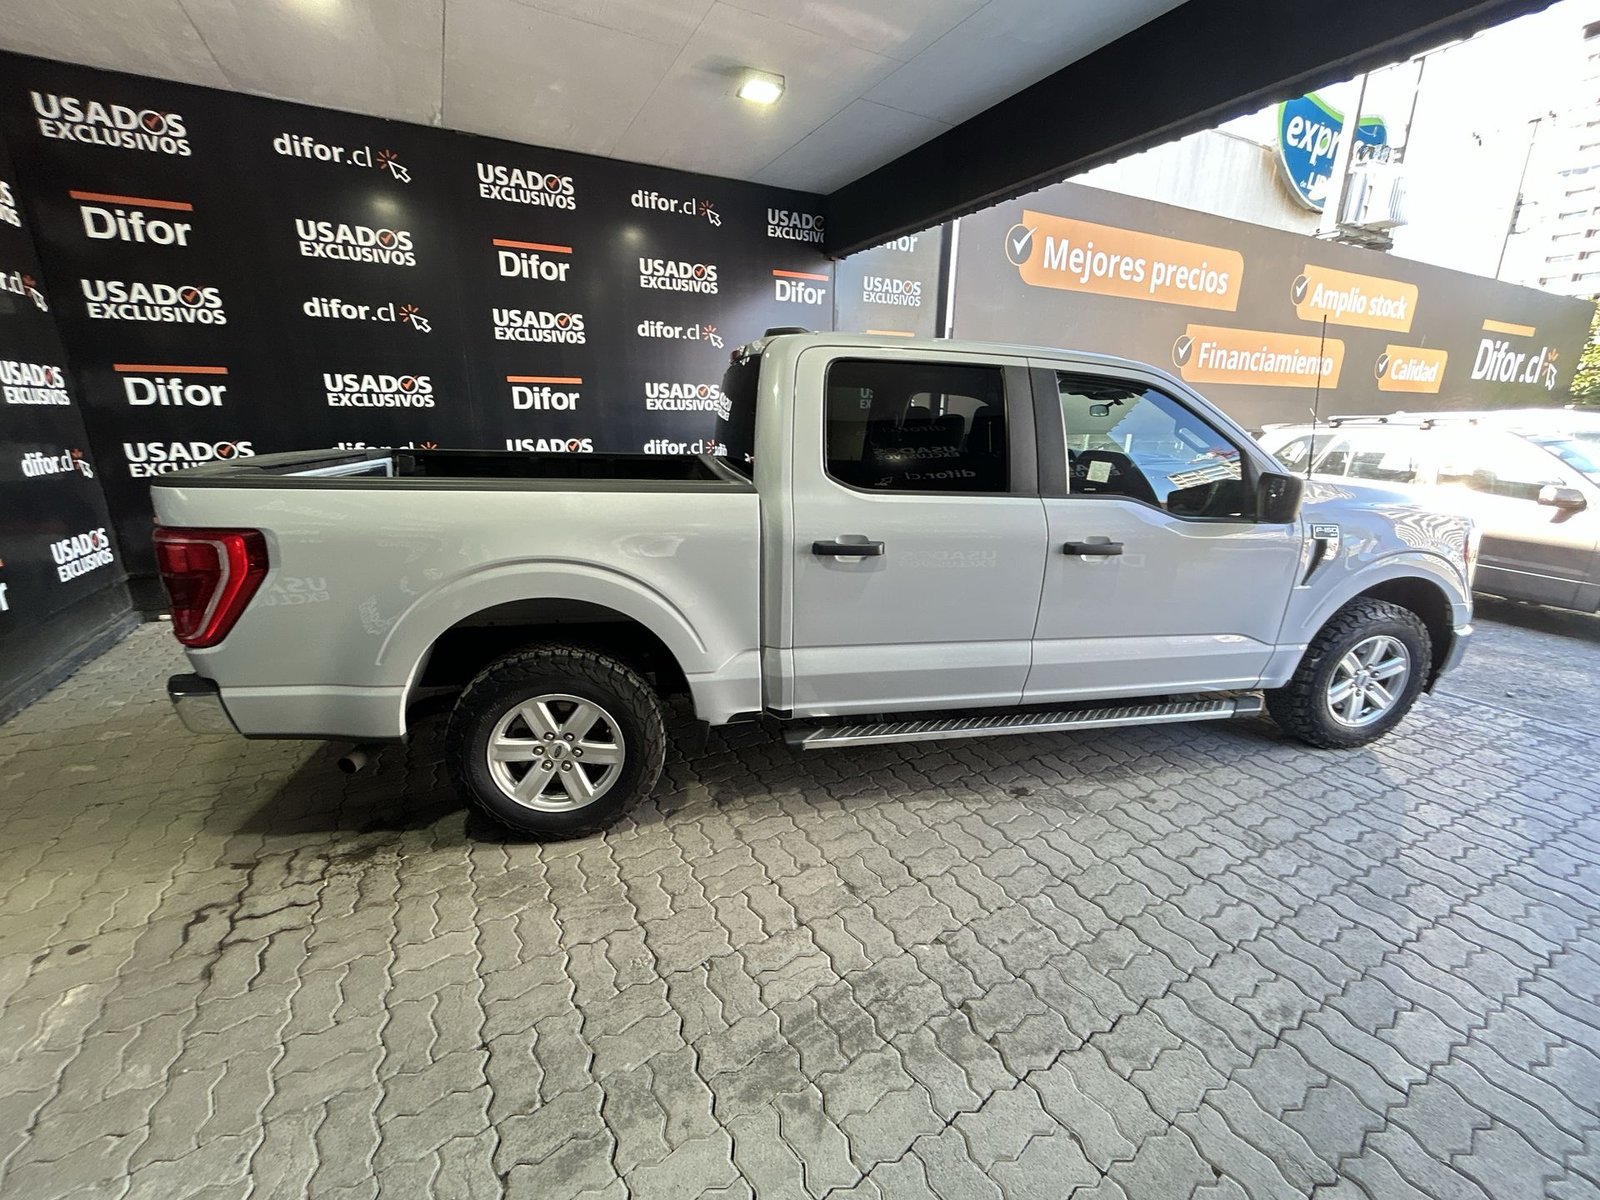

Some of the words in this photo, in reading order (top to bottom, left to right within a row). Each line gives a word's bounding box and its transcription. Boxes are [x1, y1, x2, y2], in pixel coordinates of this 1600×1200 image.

[30, 91, 187, 137] USADOS
[38, 118, 192, 156] EXCLUSIVOS
[273, 132, 373, 168] difor.cl
[1286, 115, 1340, 166] expr
[476, 162, 575, 196] USADOS
[479, 183, 576, 210] EXCLUSIVOS
[631, 189, 697, 215] difor.cl
[80, 205, 192, 246] Difor
[767, 208, 825, 231] USADO
[295, 218, 414, 251] USADOS
[767, 224, 825, 243] EXCLUSIV
[299, 240, 416, 266] EXCLUSIVOS
[498, 250, 570, 282] Difor
[1043, 236, 1146, 284] Mejores
[1149, 262, 1229, 294] precios
[639, 257, 718, 281] USADOS
[80, 279, 223, 309] USADOS
[640, 275, 718, 294] EXCLUSIVOS
[775, 279, 826, 305] Difor
[863, 275, 922, 296] USADOS
[303, 297, 396, 322] difor.cl
[862, 291, 921, 307] EXCLUSIVOS
[1309, 282, 1367, 317] Amplio
[1367, 296, 1408, 320] stock
[86, 302, 228, 325] EXCLUSIVOS
[492, 308, 585, 331] USADOS
[494, 326, 587, 344] EXCLUSIVOS
[637, 320, 700, 340] difor.cl
[1197, 342, 1334, 377] Financiamiento
[1390, 359, 1439, 383] Calidad
[1471, 338, 1548, 384] Difor.cl
[0, 360, 66, 389] USADOS
[323, 373, 433, 395] USADOS
[3, 386, 71, 406] EXCLUSIVOS
[122, 376, 228, 407] Difor
[326, 392, 435, 408] EXCLUSIVOS
[511, 386, 580, 411] Difor
[645, 382, 719, 400] USADOS
[646, 398, 721, 411] EXCLUSIVOS
[123, 440, 256, 464] USADOS
[506, 437, 594, 453] USADOS
[643, 439, 704, 455] difor.cl
[21, 449, 75, 477] difor.cl
[50, 527, 110, 565] USADOS
[57, 547, 114, 583] EXCLUSIVOS
